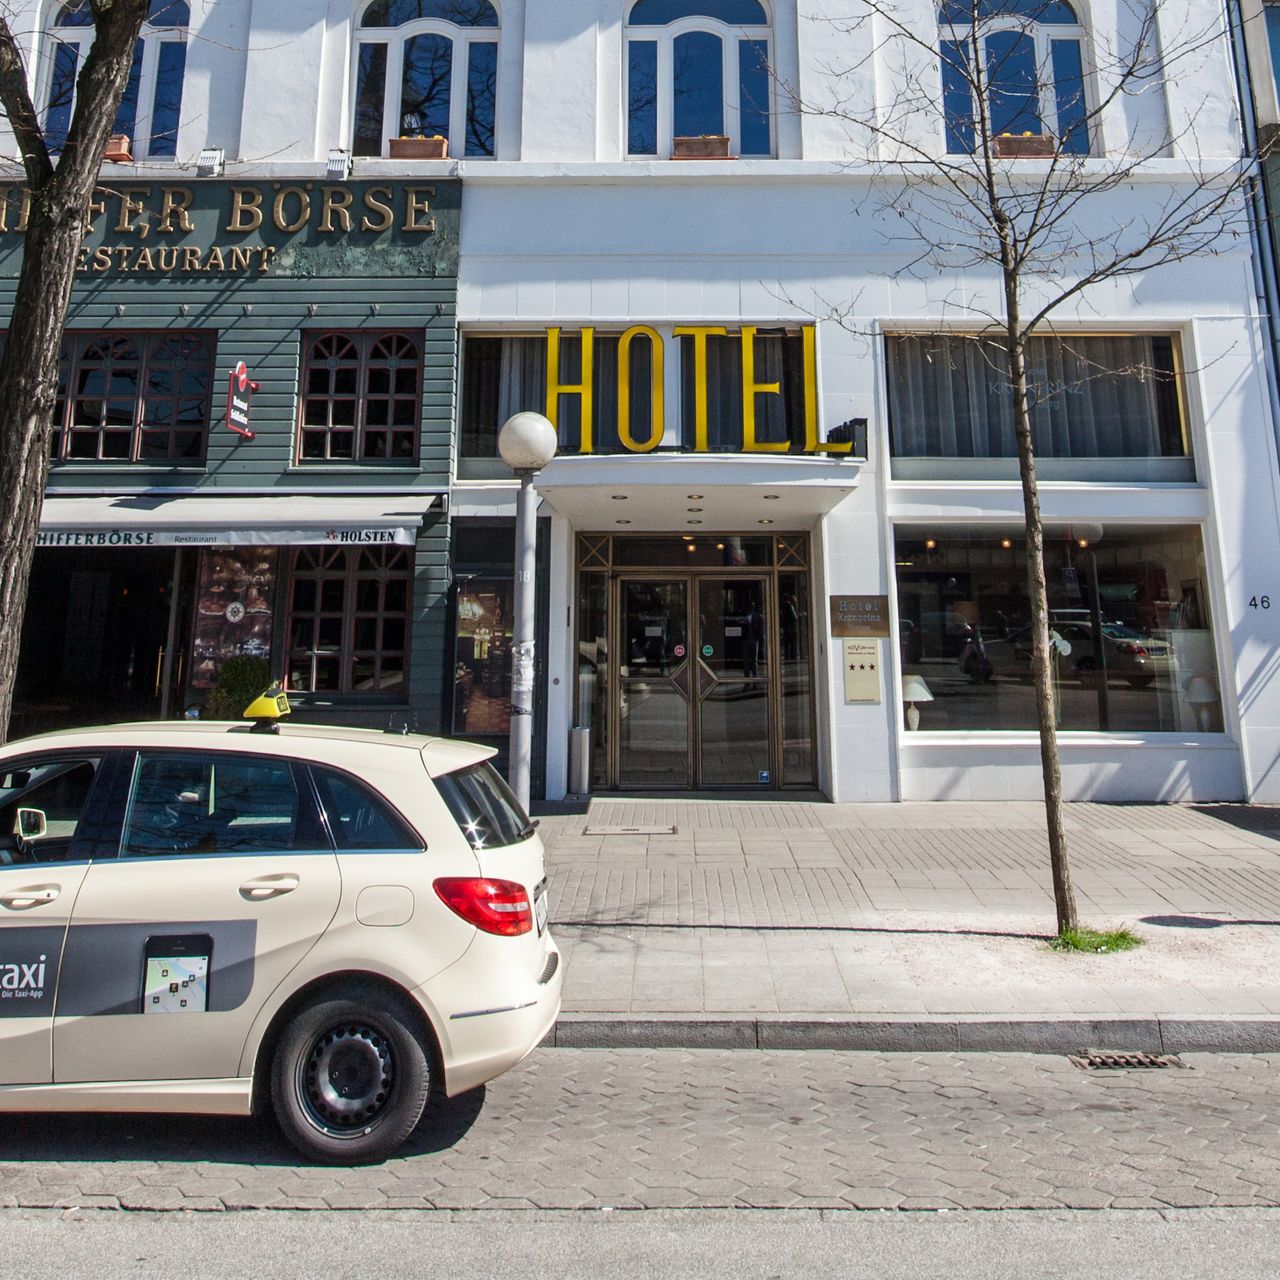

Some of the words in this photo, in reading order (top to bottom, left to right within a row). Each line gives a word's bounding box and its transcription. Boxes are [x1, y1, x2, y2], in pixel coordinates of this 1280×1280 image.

[225, 181, 437, 233] BÖRSE
[74, 246, 276, 272] ESTAURANT
[545, 324, 854, 453] HOTEL
[35, 529, 155, 546] HIFFERBÖRSE
[174, 535, 218, 544] Restaurant
[341, 530, 396, 543] HOLSTEN
[519, 570, 531, 583] 18
[1248, 595, 1271, 610] 46
[1, 990, 13, 999] Die
[15, 989, 44, 999] Taxi-App
